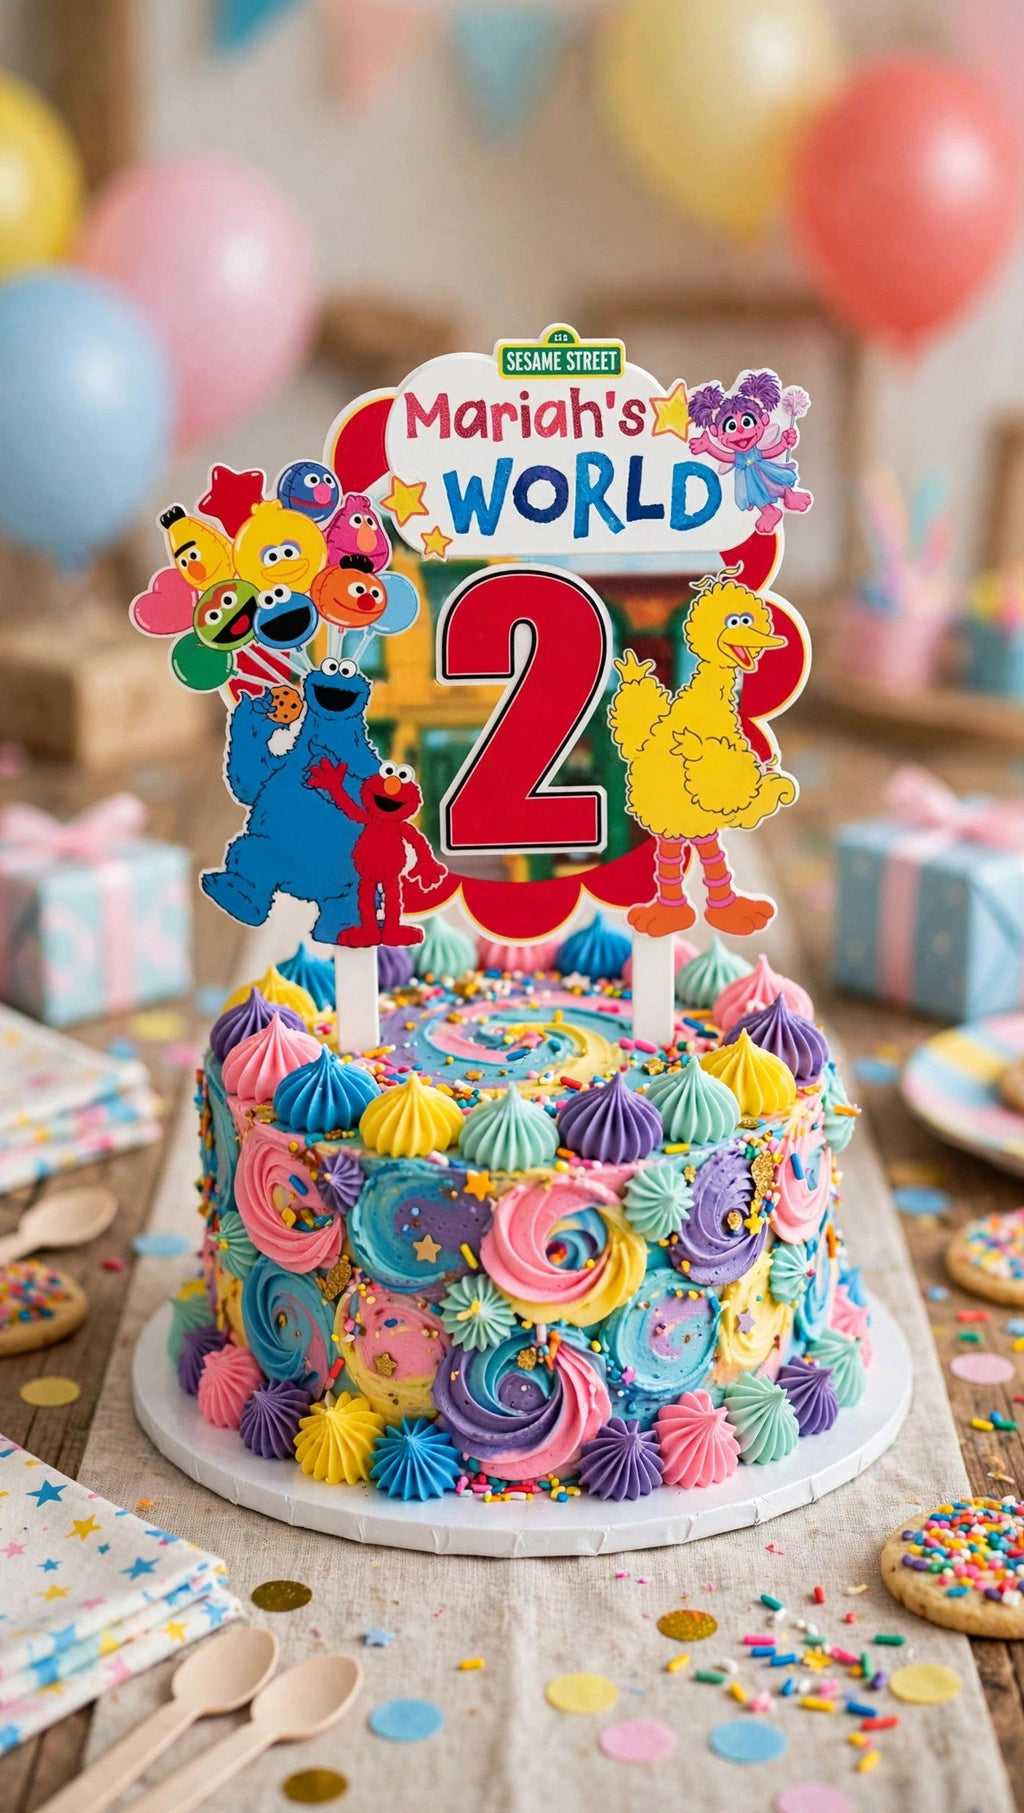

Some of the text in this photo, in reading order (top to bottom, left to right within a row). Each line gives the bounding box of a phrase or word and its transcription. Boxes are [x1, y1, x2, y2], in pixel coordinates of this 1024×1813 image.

[506, 351, 618, 371] SESAME STREET
[404, 387, 647, 442] Mariah's
[443, 451, 722, 539] WORLD
[442, 569, 607, 850] 2
